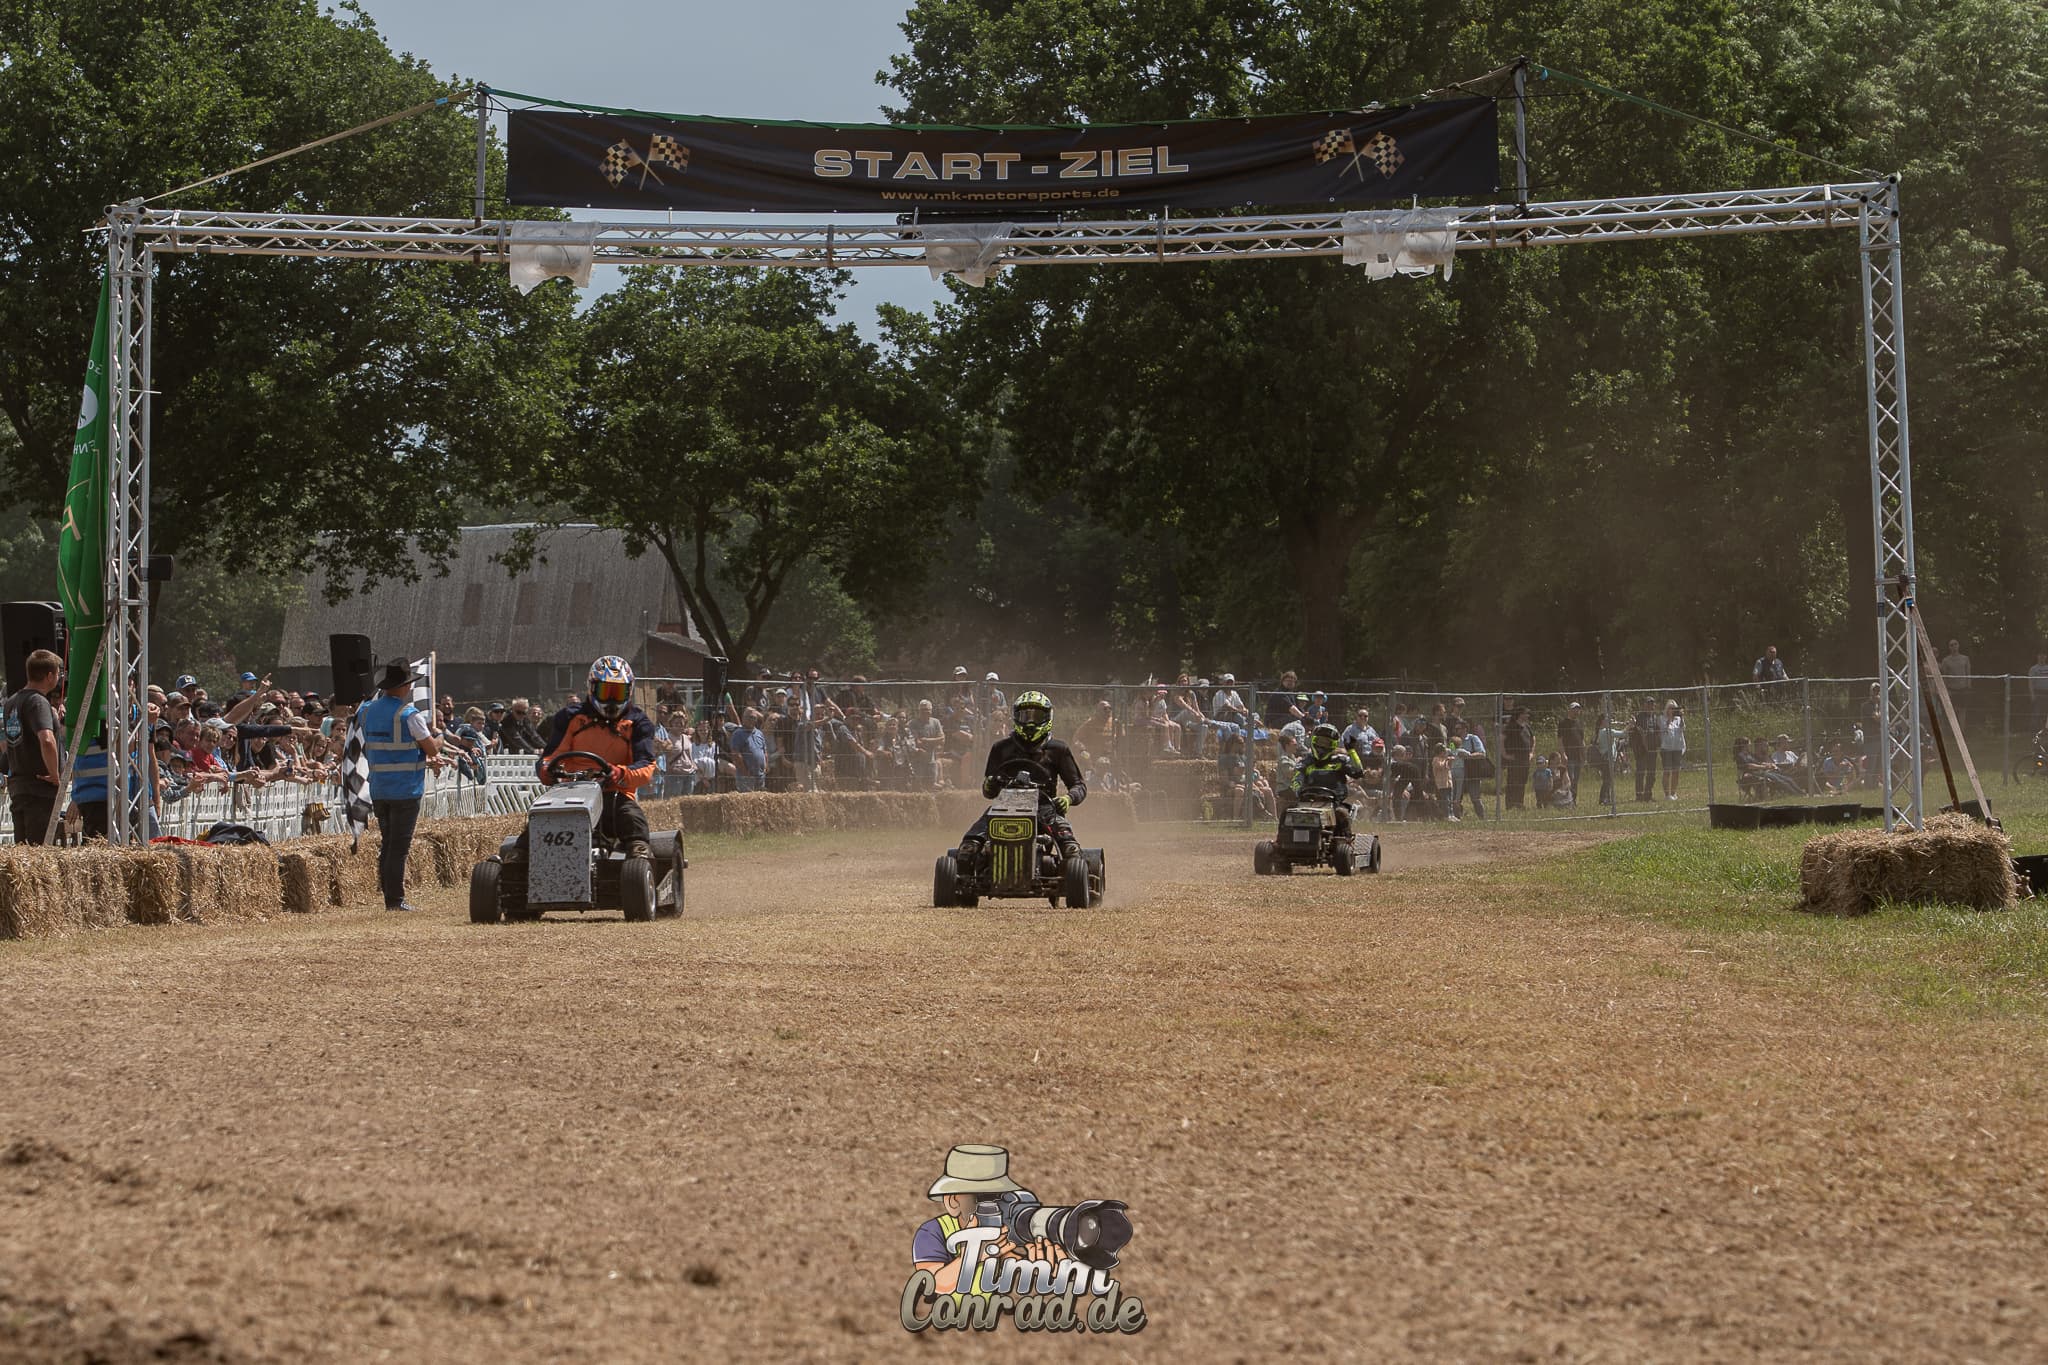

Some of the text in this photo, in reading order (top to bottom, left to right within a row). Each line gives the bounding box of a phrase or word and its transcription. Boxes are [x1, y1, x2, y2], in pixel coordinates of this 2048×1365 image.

[814, 149, 1021, 180] START
[1059, 146, 1189, 178] ZIEL
[880, 188, 1120, 202] www.mk-motorsports.de
[543, 831, 575, 846] 462
